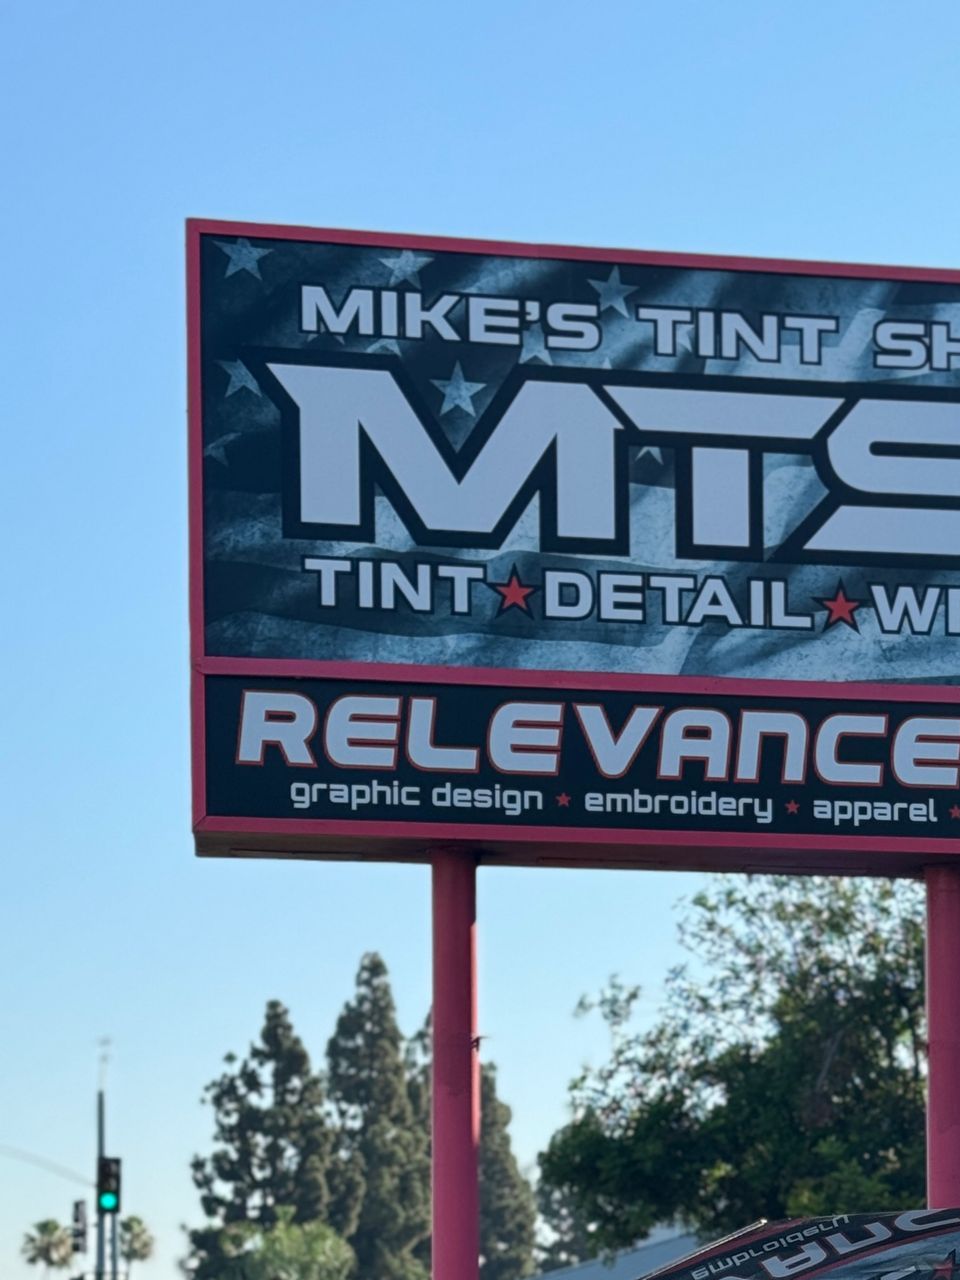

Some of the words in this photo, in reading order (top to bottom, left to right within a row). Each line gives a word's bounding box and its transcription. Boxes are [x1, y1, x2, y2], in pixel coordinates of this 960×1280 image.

[299, 284, 600, 352] MIKE'S
[637, 307, 838, 366] TINT
[303, 557, 487, 615] TINT
[543, 569, 813, 632] DETAIL
[290, 779, 422, 816] graphic
[431, 779, 543, 817] design
[584, 786, 773, 824] embroidery
[813, 799, 938, 827] apparel
